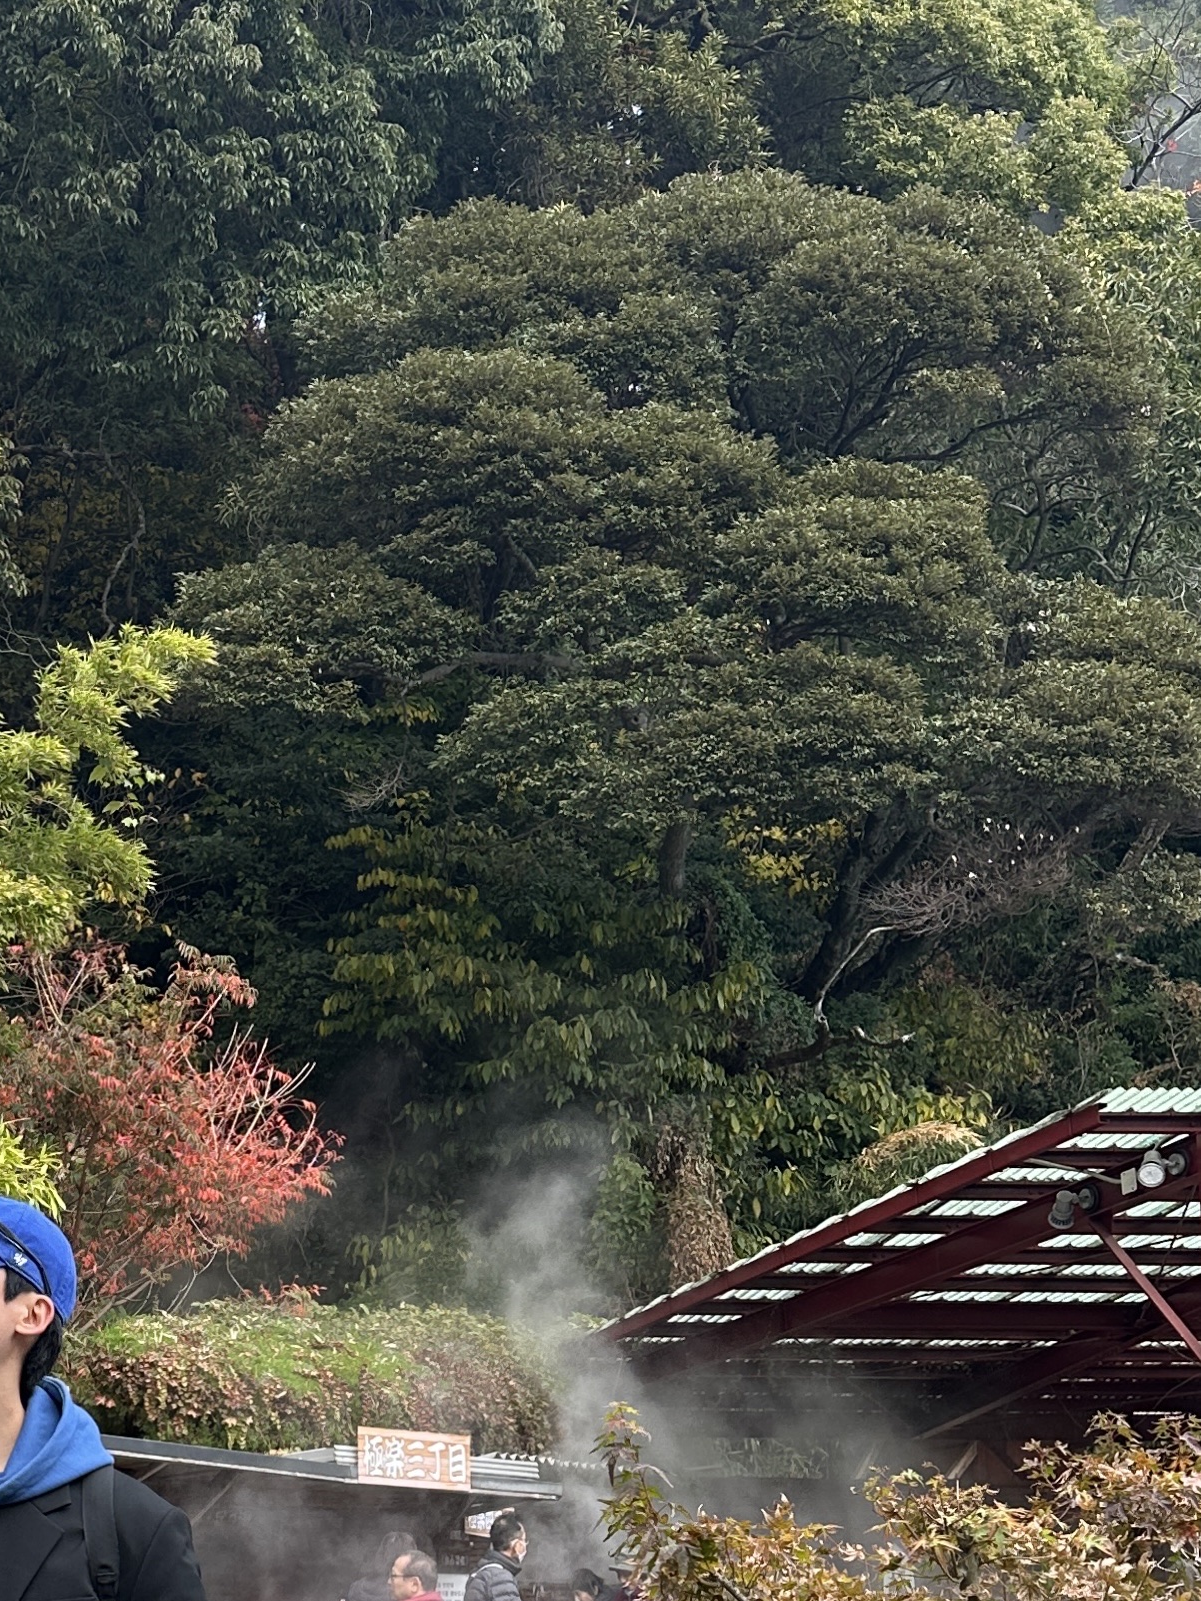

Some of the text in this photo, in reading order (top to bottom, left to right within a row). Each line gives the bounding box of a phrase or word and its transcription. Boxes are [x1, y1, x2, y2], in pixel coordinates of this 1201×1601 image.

[363, 1434, 467, 1483] 極楽三丁目
